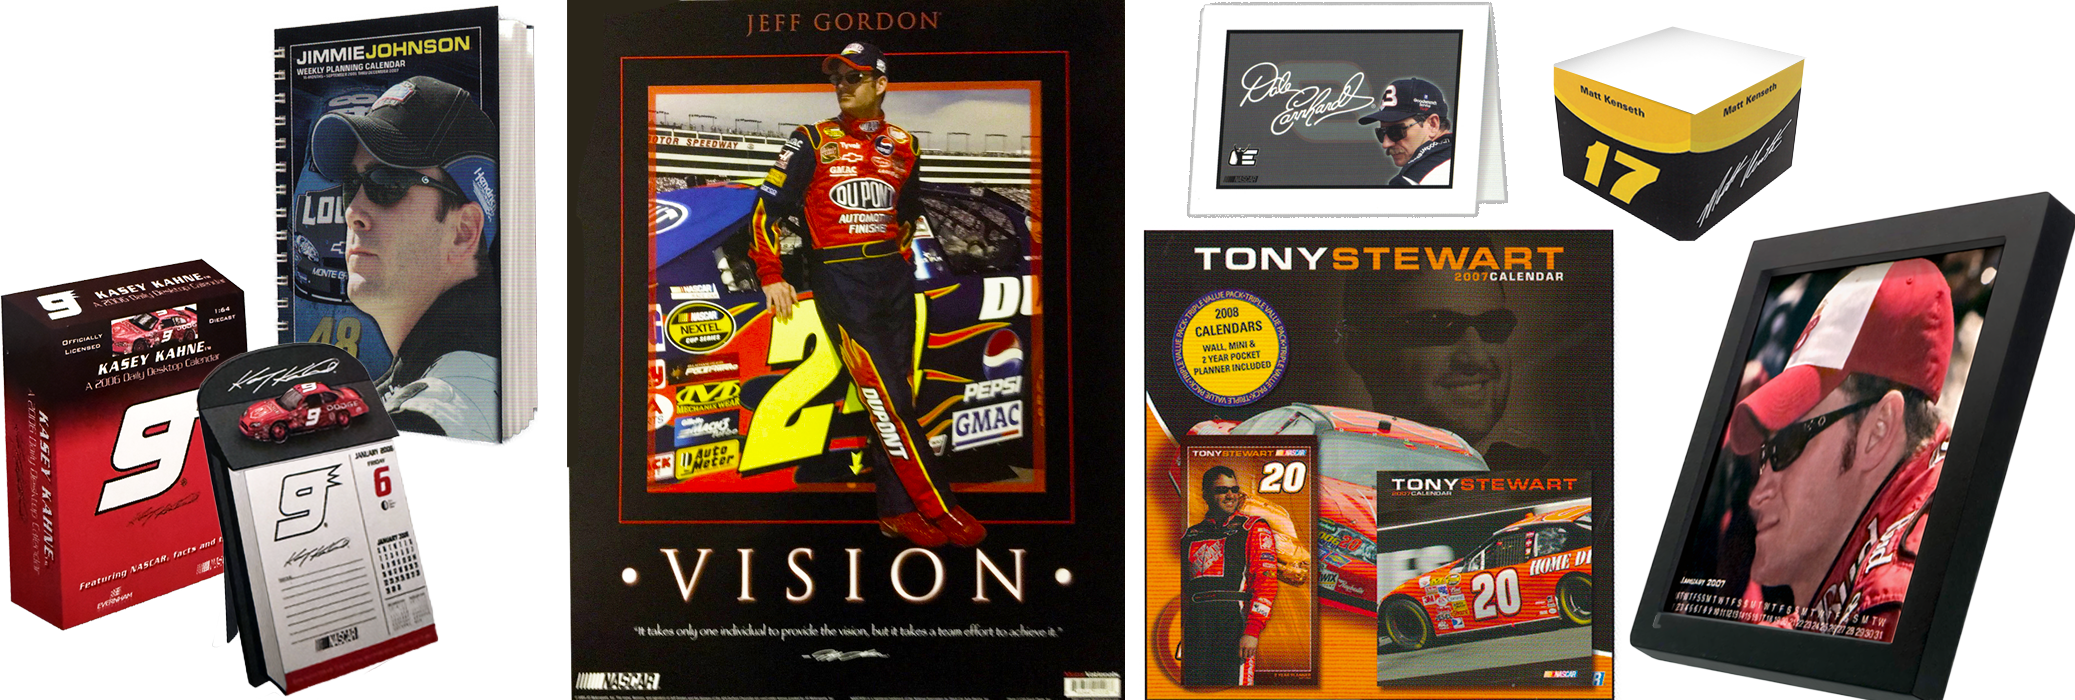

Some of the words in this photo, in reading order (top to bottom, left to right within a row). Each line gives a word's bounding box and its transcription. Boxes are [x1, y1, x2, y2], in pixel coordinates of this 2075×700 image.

[746, 13, 801, 37] JEFF
[813, 12, 939, 32] GORDON
[296, 67, 325, 76] WEEKLY
[326, 63, 364, 73] PLANNING
[365, 60, 406, 70] CALENDAR
[1240, 61, 1304, 107] Dale
[1271, 72, 1375, 136] Earnhardt
[1382, 84, 1398, 107] 3
[1580, 84, 1602, 102] Matt
[1604, 93, 1645, 118] Kenseth
[1723, 99, 1744, 118] Matt
[1746, 82, 1778, 105] Kenseth
[687, 138, 739, 149] SPEEDWAY
[829, 166, 857, 174] GMAC
[1583, 140, 1661, 205] 17
[312, 267, 337, 279] MONTE
[94, 283, 146, 299] KASEY
[151, 272, 204, 289] KAHNE
[684, 284, 714, 293] NASCAR
[37, 290, 82, 321] 9
[214, 306, 231, 314] 1:64
[691, 310, 719, 322] NASCAR
[1215, 306, 1239, 319] 2008
[161, 329, 173, 343] 9
[680, 322, 721, 335] NEXTEL
[685, 336, 698, 344] CUP
[699, 334, 721, 343] SERIES
[1195, 320, 1263, 338] CALENDARS
[1202, 343, 1227, 352] WALL,
[1228, 341, 1248, 350] MINI
[1249, 340, 1256, 348] &
[1208, 353, 1229, 363] YEAR
[1230, 350, 1261, 361] POCKET
[98, 353, 150, 376] KASEY
[155, 340, 206, 362] KAHNE
[1193, 365, 1231, 375] PLANNER
[1232, 360, 1272, 372] INCLUDED
[85, 382, 93, 391] A
[94, 377, 121, 389] 2006
[123, 370, 145, 382] Daily
[147, 362, 184, 377] Desktop
[185, 352, 221, 368] Calendar
[963, 375, 1023, 403] PEPSI
[305, 406, 321, 427] 9
[326, 401, 359, 411] DODGE
[676, 403, 717, 415] MECHANIX
[718, 398, 740, 409] WEAR
[861, 387, 909, 461] DUPONT
[955, 403, 1020, 437] GMAC
[38, 410, 52, 481] KASEY
[94, 389, 203, 516] 9
[355, 449, 379, 460] JANUARY
[695, 446, 728, 459] Auto
[692, 454, 735, 473] Meter
[373, 466, 392, 497] 6
[1258, 460, 1308, 494] 20
[275, 463, 343, 542] 9
[41, 485, 55, 562] KAHNE
[1339, 535, 1362, 552] 20
[79, 570, 128, 591] Featuring
[173, 546, 196, 559] facts
[199, 538, 216, 550] and
[660, 547, 1027, 603] VISION
[1530, 553, 1571, 576] HOME
[1706, 579, 1727, 588] 2007
[1470, 568, 1522, 622] 20
[647, 623, 674, 637] takes
[676, 623, 698, 641] only
[699, 628, 718, 637] one
[720, 623, 766, 637] individual
[768, 626, 780, 637] to
[781, 623, 818, 641] provide
[820, 623, 837, 637] the
[838, 625, 870, 638] vision,
[871, 623, 889, 637] but
[890, 625, 899, 637] it
[900, 623, 928, 637] takes
[929, 628, 937, 637] a
[938, 626, 962, 637] team
[963, 623, 995, 637] effort
[995, 626, 1008, 637] to
[1008, 623, 1047, 637] achieve
